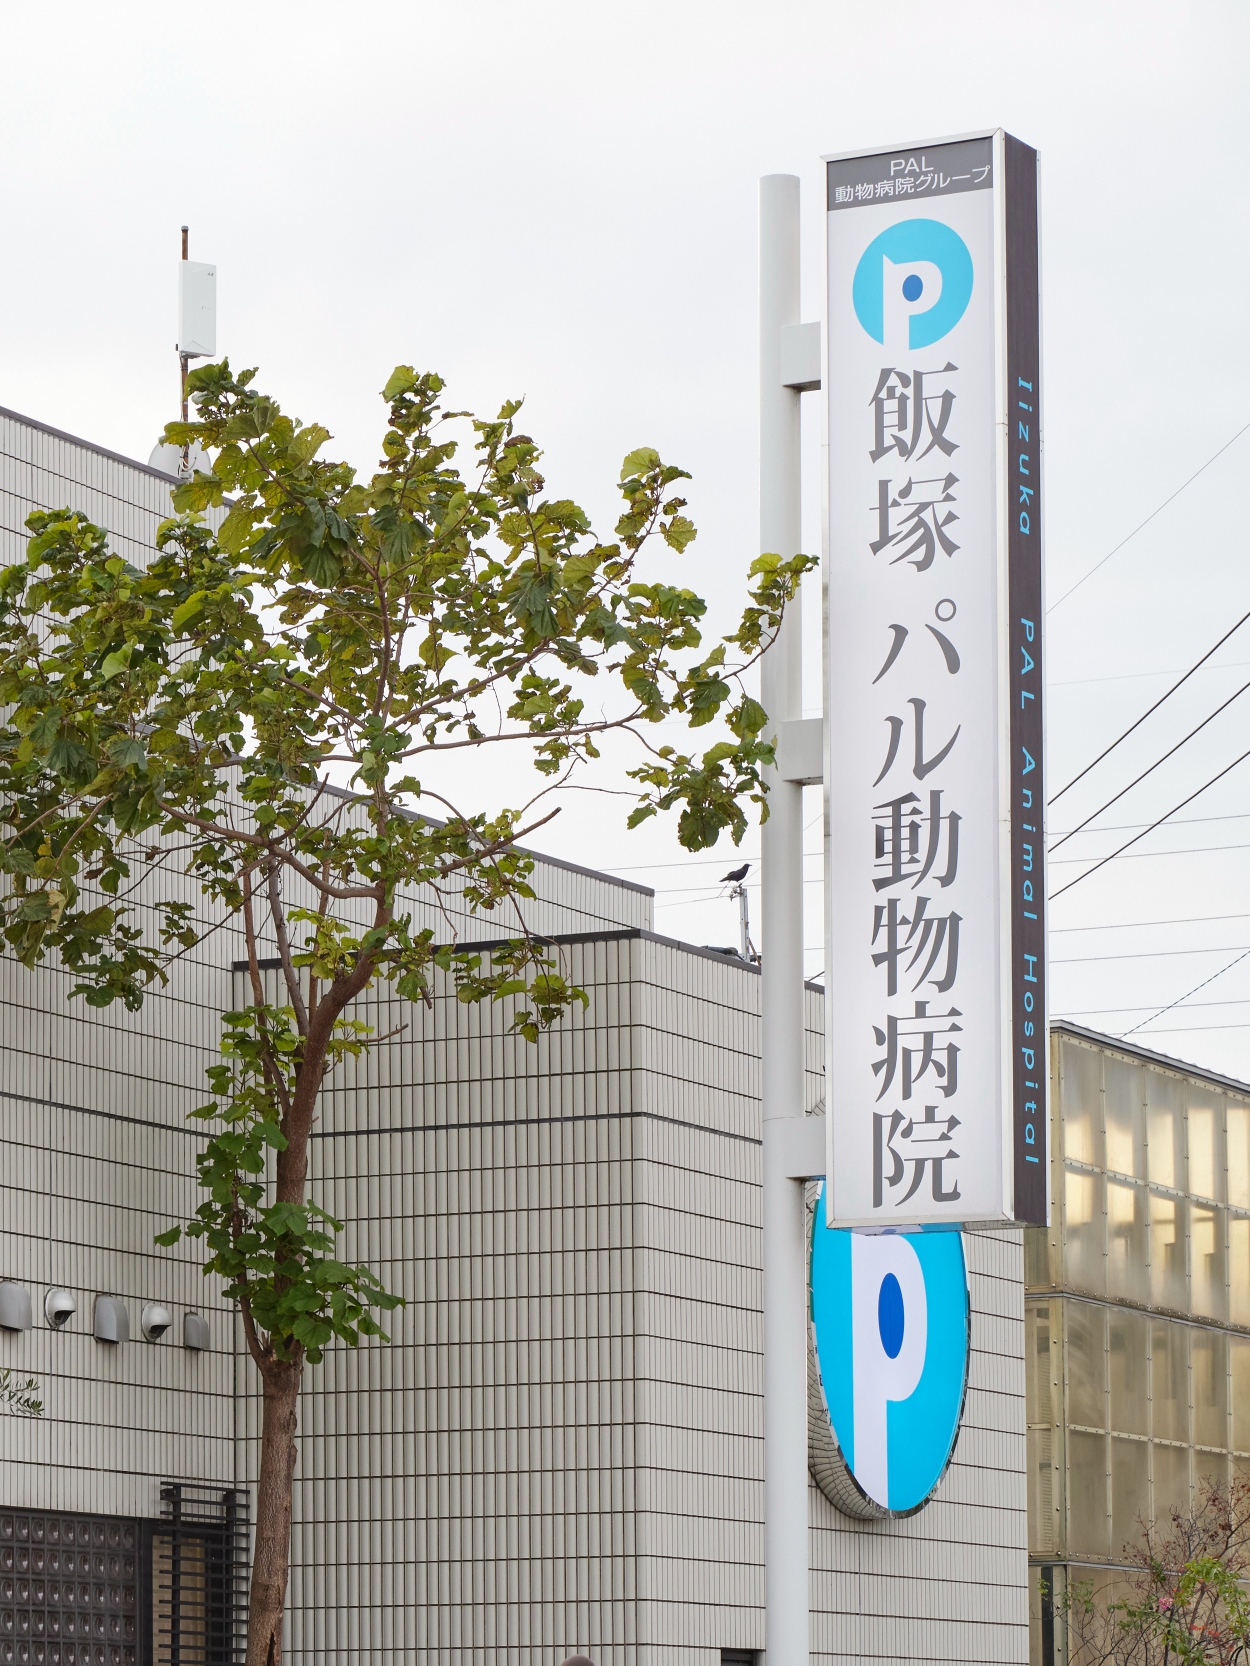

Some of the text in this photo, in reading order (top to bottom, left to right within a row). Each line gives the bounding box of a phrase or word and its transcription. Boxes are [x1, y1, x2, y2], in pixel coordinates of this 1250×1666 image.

[835, 164, 991, 203] 動物病院グループ
[890, 156, 934, 176] PAL
[1018, 376, 1039, 1163] Iizuka PAL Animal Hospital
